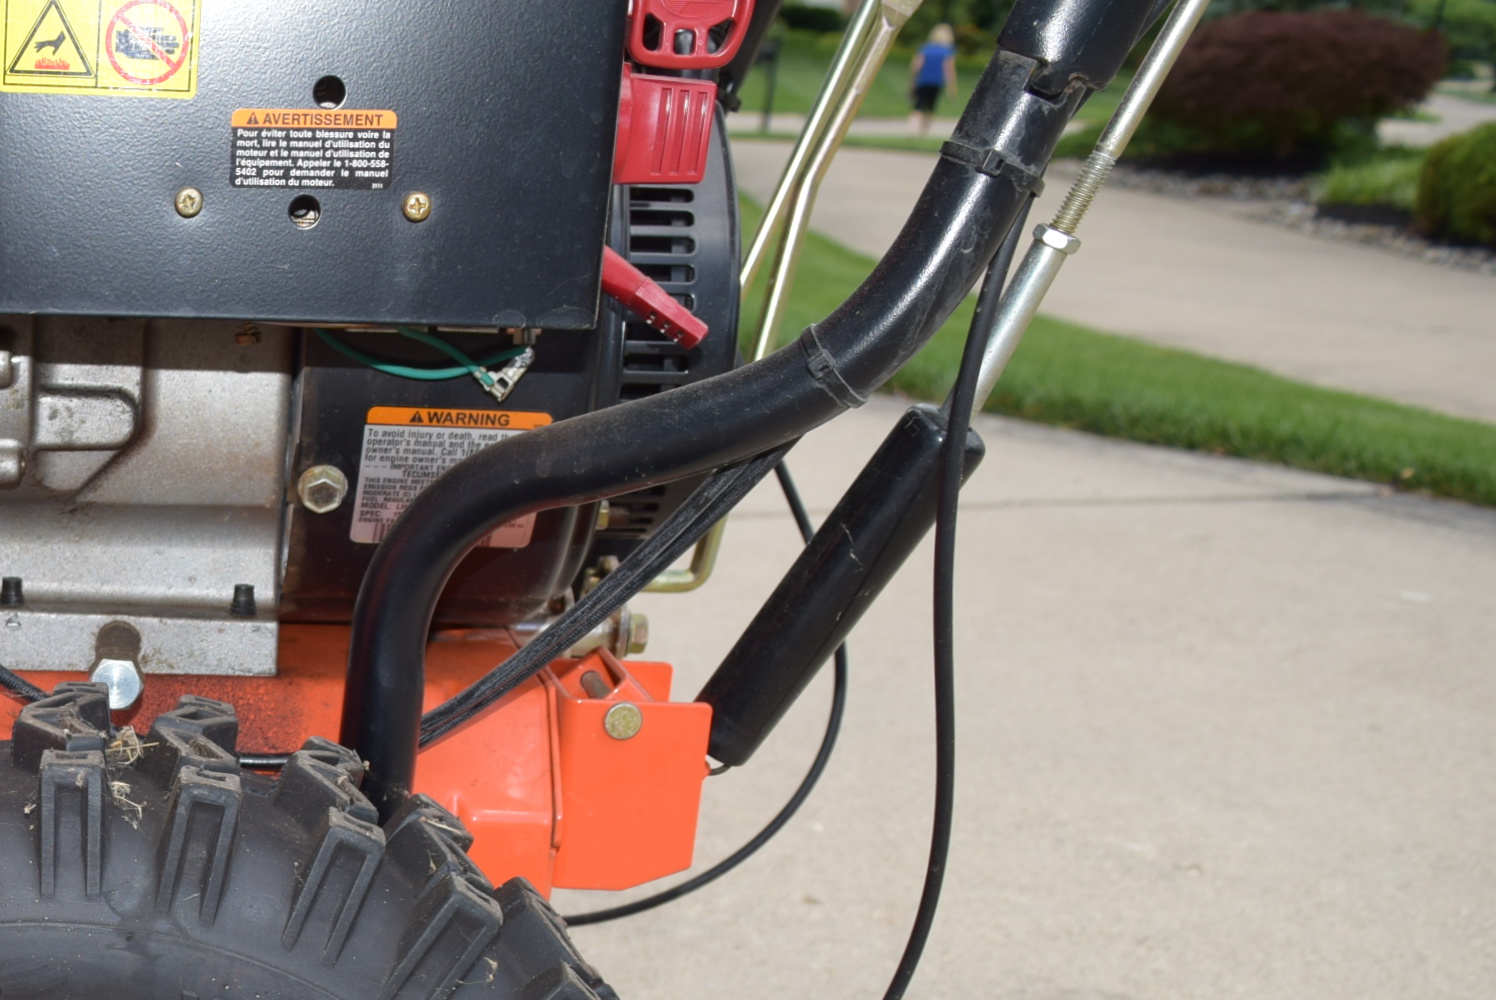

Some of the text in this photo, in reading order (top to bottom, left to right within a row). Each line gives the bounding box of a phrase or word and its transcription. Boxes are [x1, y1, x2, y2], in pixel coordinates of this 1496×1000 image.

[263, 113, 383, 126] AVERTISSEMENT
[237, 129, 391, 139] Pour éviter toute blessure voire la
[237, 139, 390, 149] mort, lire le manuel d'utilisation du
[280, 149, 289, 157] le
[290, 150, 323, 158] manuel
[325, 150, 376, 158] d'utilisation
[378, 150, 390, 158] de
[235, 158, 389, 168] l'équipement. Appeler le 1-800-558-
[235, 168, 389, 178] 5402 pour demander le manuel
[235, 177, 335, 187] d'utilisation du moteur.
[427, 411, 510, 426] WARNING
[368, 428, 378, 437] To
[382, 430, 405, 439] avoid
[408, 431, 433, 441] injury
[436, 432, 445, 440] or
[448, 431, 475, 442] death,
[478, 433, 498, 441] read
[367, 438, 410, 448] operator's
[414, 439, 445, 448] manual
[449, 440, 464, 449] and
[366, 446, 400, 454] owner's
[404, 447, 438, 456] manual.
[441, 448, 458, 457] Call
[380, 454, 408, 464] engine
[413, 456, 446, 464] owner's
